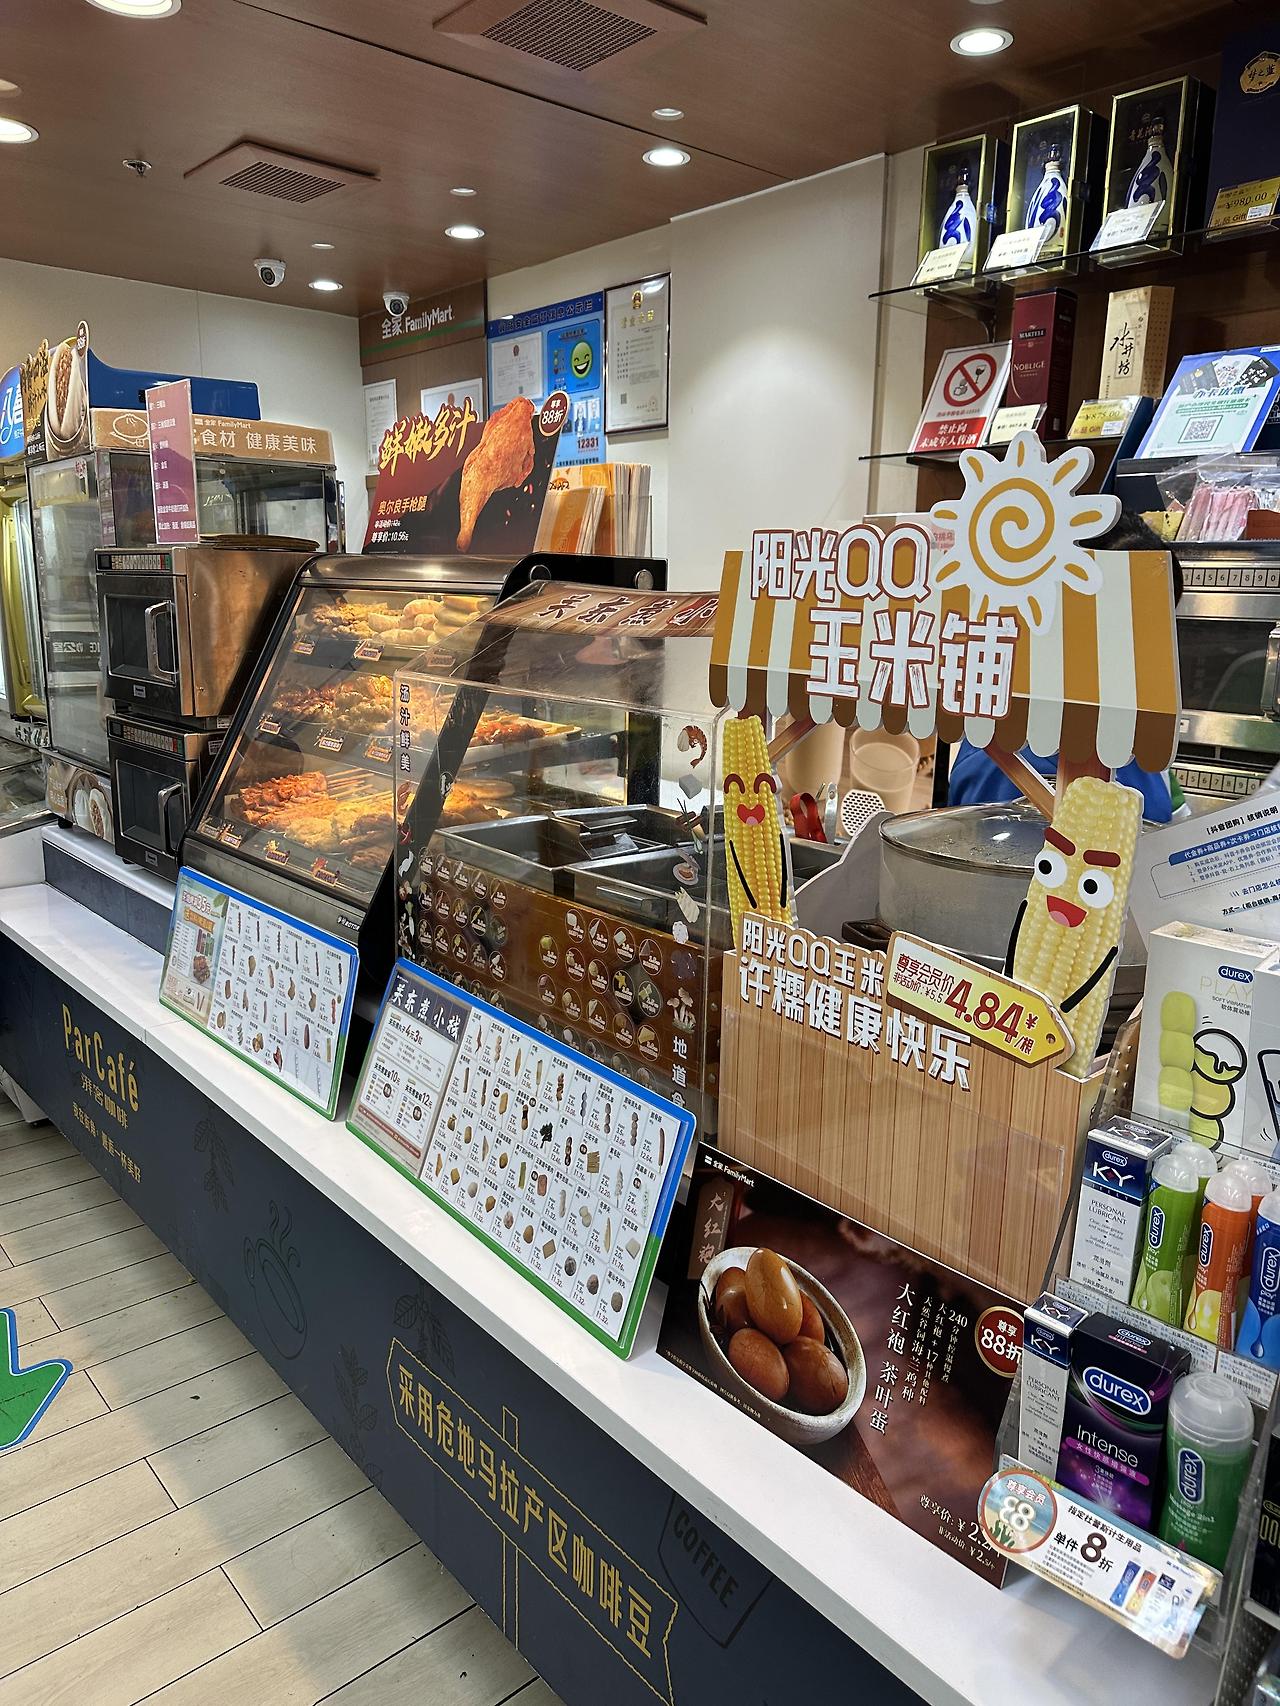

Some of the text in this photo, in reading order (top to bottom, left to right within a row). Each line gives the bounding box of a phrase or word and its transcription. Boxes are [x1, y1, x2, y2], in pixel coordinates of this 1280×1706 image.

[381, 305, 453, 340] 全家 FamilyMart
[1019, 330, 1045, 339] MARTELL
[1013, 360, 1046, 372] NOBLIGE
[1108, 321, 1135, 376] 水井坊
[541, 409, 565, 425] 88折
[245, 431, 318, 455] 健康美味
[577, 436, 599, 449] 12331
[377, 495, 428, 516] 奥尔良手枪腿
[751, 523, 930, 602] 阳光QQ
[806, 607, 1019, 719] 玉米铺
[399, 684, 411, 772] 汤汁鲜美
[743, 916, 884, 998] 阳光QQ玉米
[896, 953, 955, 995] 尊享会员价
[1220, 966, 1251, 983] durex
[944, 979, 1024, 1044] 4.84
[62, 1003, 140, 1112] ParCafé
[724, 1165, 755, 1188] FamilyMart
[1104, 1152, 1125, 1166] durex
[1088, 1206, 1127, 1226] LUBRICANT
[1091, 1199, 1126, 1218] PERSONAL
[1150, 1209, 1164, 1244] durex
[1200, 1226, 1213, 1262] durex
[1263, 1251, 1280, 1288] durex
[981, 1328, 1024, 1365] 88折
[1119, 1329, 1150, 1345] durex
[869, 1282, 916, 1435] 大红袍 茶叶蛋
[1026, 1381, 1060, 1402] LUBRICANT
[1028, 1375, 1059, 1395] PERSONAL
[1089, 1373, 1144, 1413] durex
[1077, 1424, 1139, 1468] Intense
[1183, 1453, 1200, 1497] durex
[398, 1363, 652, 1659] 采用危地马拉产区咖啡豆
[999, 1495, 1036, 1532] 88
[1067, 1505, 1143, 1553] 指定杜蕾斯计生用品
[674, 1508, 739, 1609] COFFEE
[1053, 1531, 1079, 1552] 单件
[1080, 1532, 1107, 1562] 8
[1099, 1557, 1114, 1573] 折
